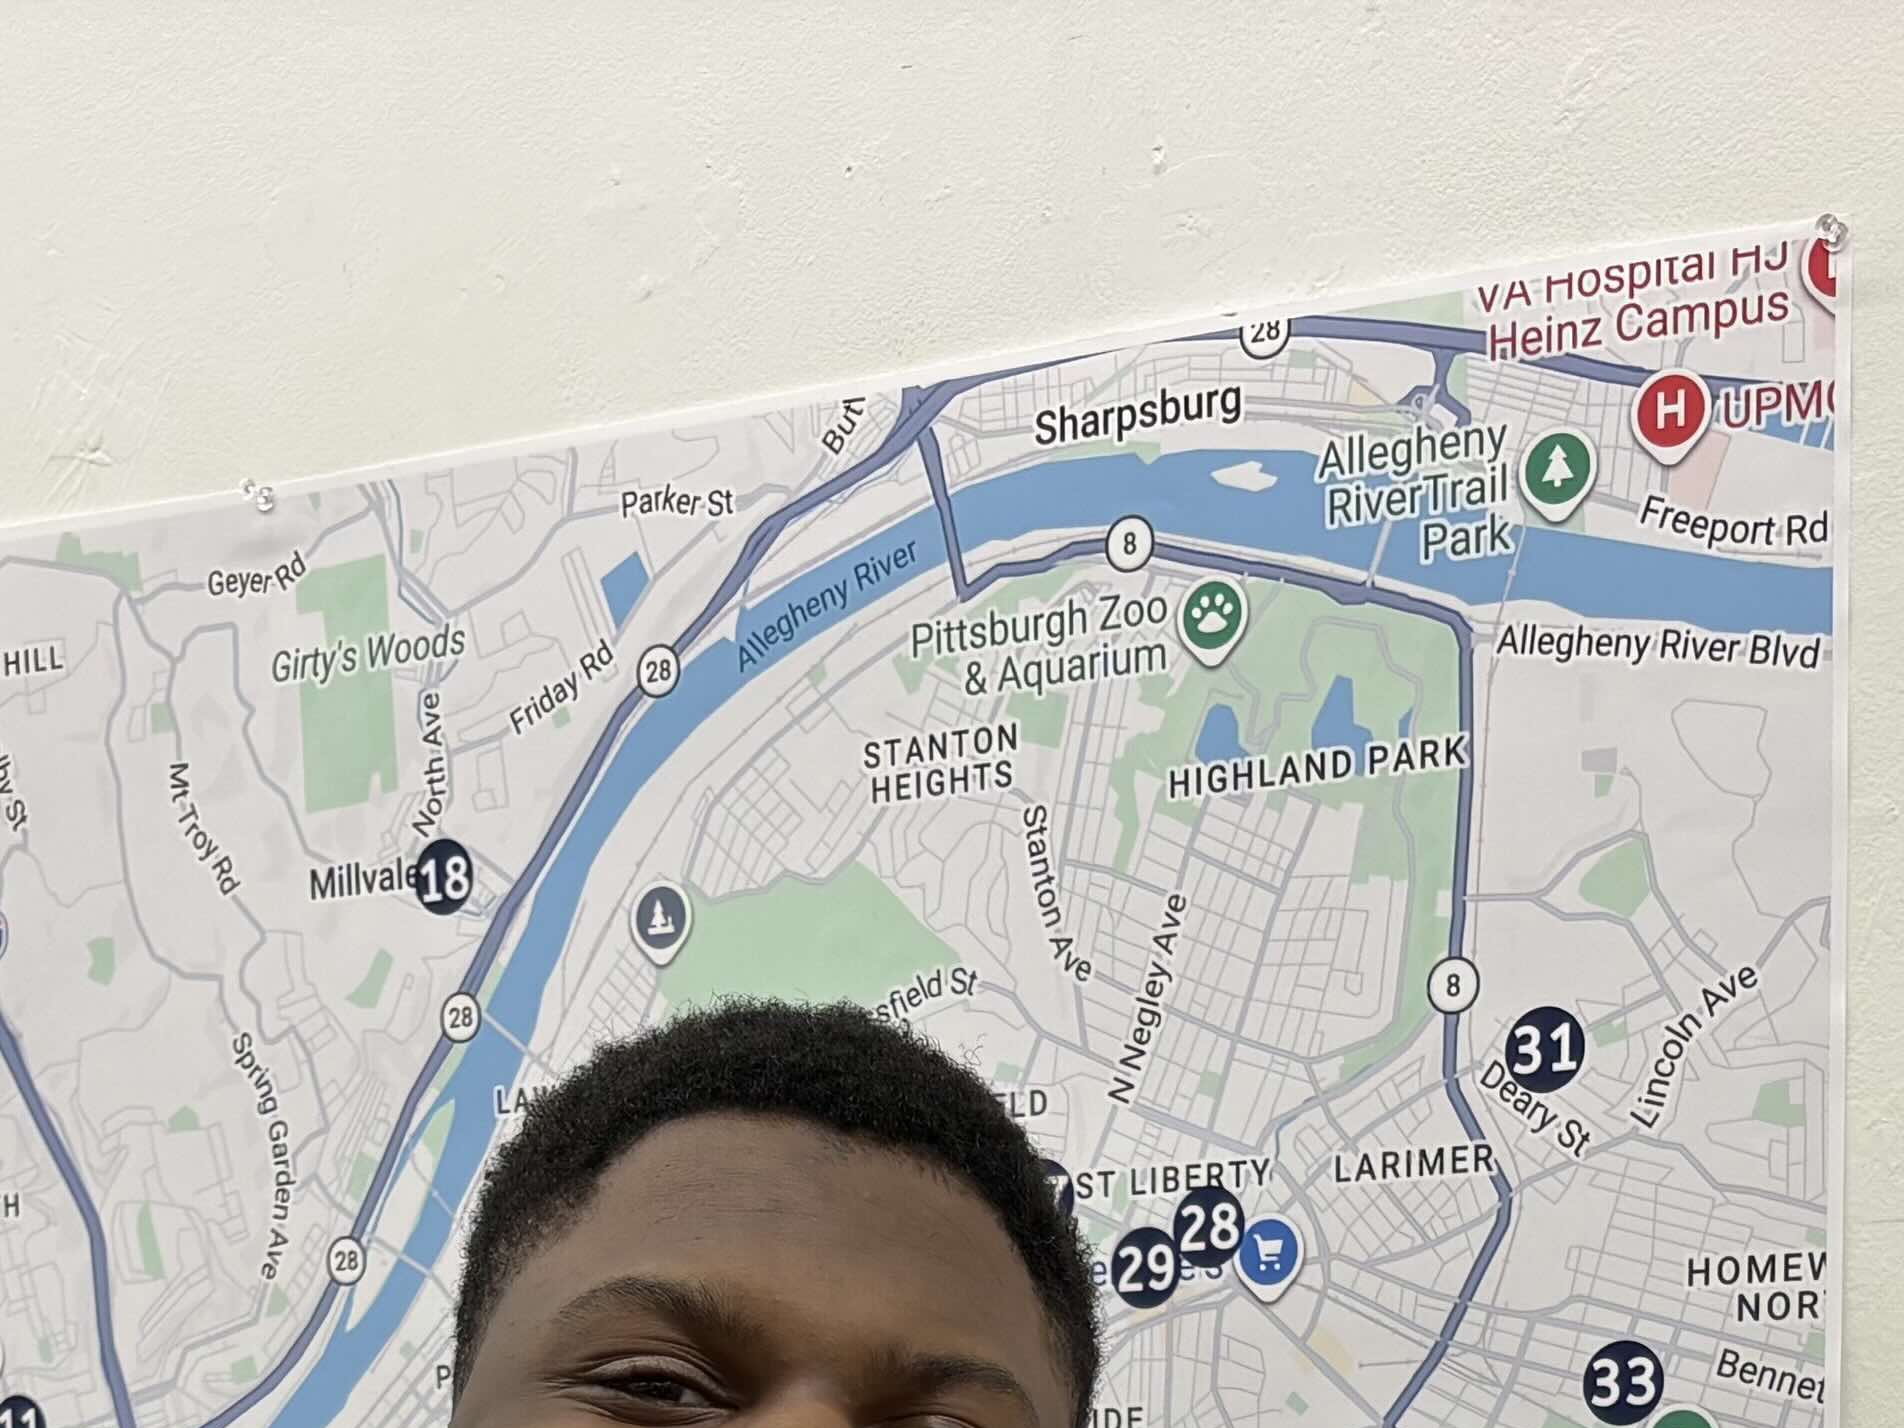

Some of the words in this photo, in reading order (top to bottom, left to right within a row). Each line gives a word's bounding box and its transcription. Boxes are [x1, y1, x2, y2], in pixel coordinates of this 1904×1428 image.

[1490, 315, 1602, 362] Heinz
[1616, 291, 1789, 341] Campus
[1034, 386, 1242, 446] Sharpsburg
[1319, 425, 1508, 479] Allegheny
[621, 486, 702, 518] Parker
[707, 490, 734, 516] St
[1640, 495, 1776, 547] Freeport
[1786, 510, 1829, 545] Rd
[1422, 517, 1511, 561] Park
[208, 571, 272, 598] Geyer
[273, 551, 308, 591] Rd
[738, 594, 849, 673] Allegheny
[854, 540, 919, 595] River
[912, 601, 1087, 659] Pittsburgh
[1100, 595, 1166, 630] Zoo
[3, 645, 64, 678] HILL
[272, 639, 357, 684] Girty's
[367, 623, 467, 666] Woods
[646, 659, 672, 683] 28
[964, 663, 987, 695] &
[997, 641, 1166, 696] Aquarium
[1498, 624, 1651, 665] Allegheny
[1661, 629, 1740, 663] River
[1750, 635, 1821, 669] Blvd
[509, 674, 580, 736] Friday
[579, 640, 615, 682] Rd
[422, 692, 441, 746] Ave
[864, 723, 1019, 769] STANTON
[1169, 751, 1352, 798] HIGHLAND
[1368, 735, 1466, 775] PARK
[413, 754, 445, 838] North
[872, 760, 1012, 803] HEIGHTS
[310, 863, 418, 901] Millvale
[421, 861, 471, 902] 18
[1023, 804, 1061, 929] Stanton
[1049, 934, 1091, 983] Ave
[1513, 1023, 1577, 1073] 31
[1631, 1013, 1703, 1128] Lincoln
[1702, 965, 1758, 1016] Ave
[232, 1031, 279, 1116] Spring
[268, 1120, 297, 1222] Garden
[1130, 1158, 1271, 1196] LIBERTY
[1335, 1144, 1495, 1183] LARIMER
[1181, 1202, 1239, 1251] 28
[262, 1227, 290, 1282] Ave
[1118, 1243, 1175, 1293] 29
[1591, 1358, 1656, 1406] 33
